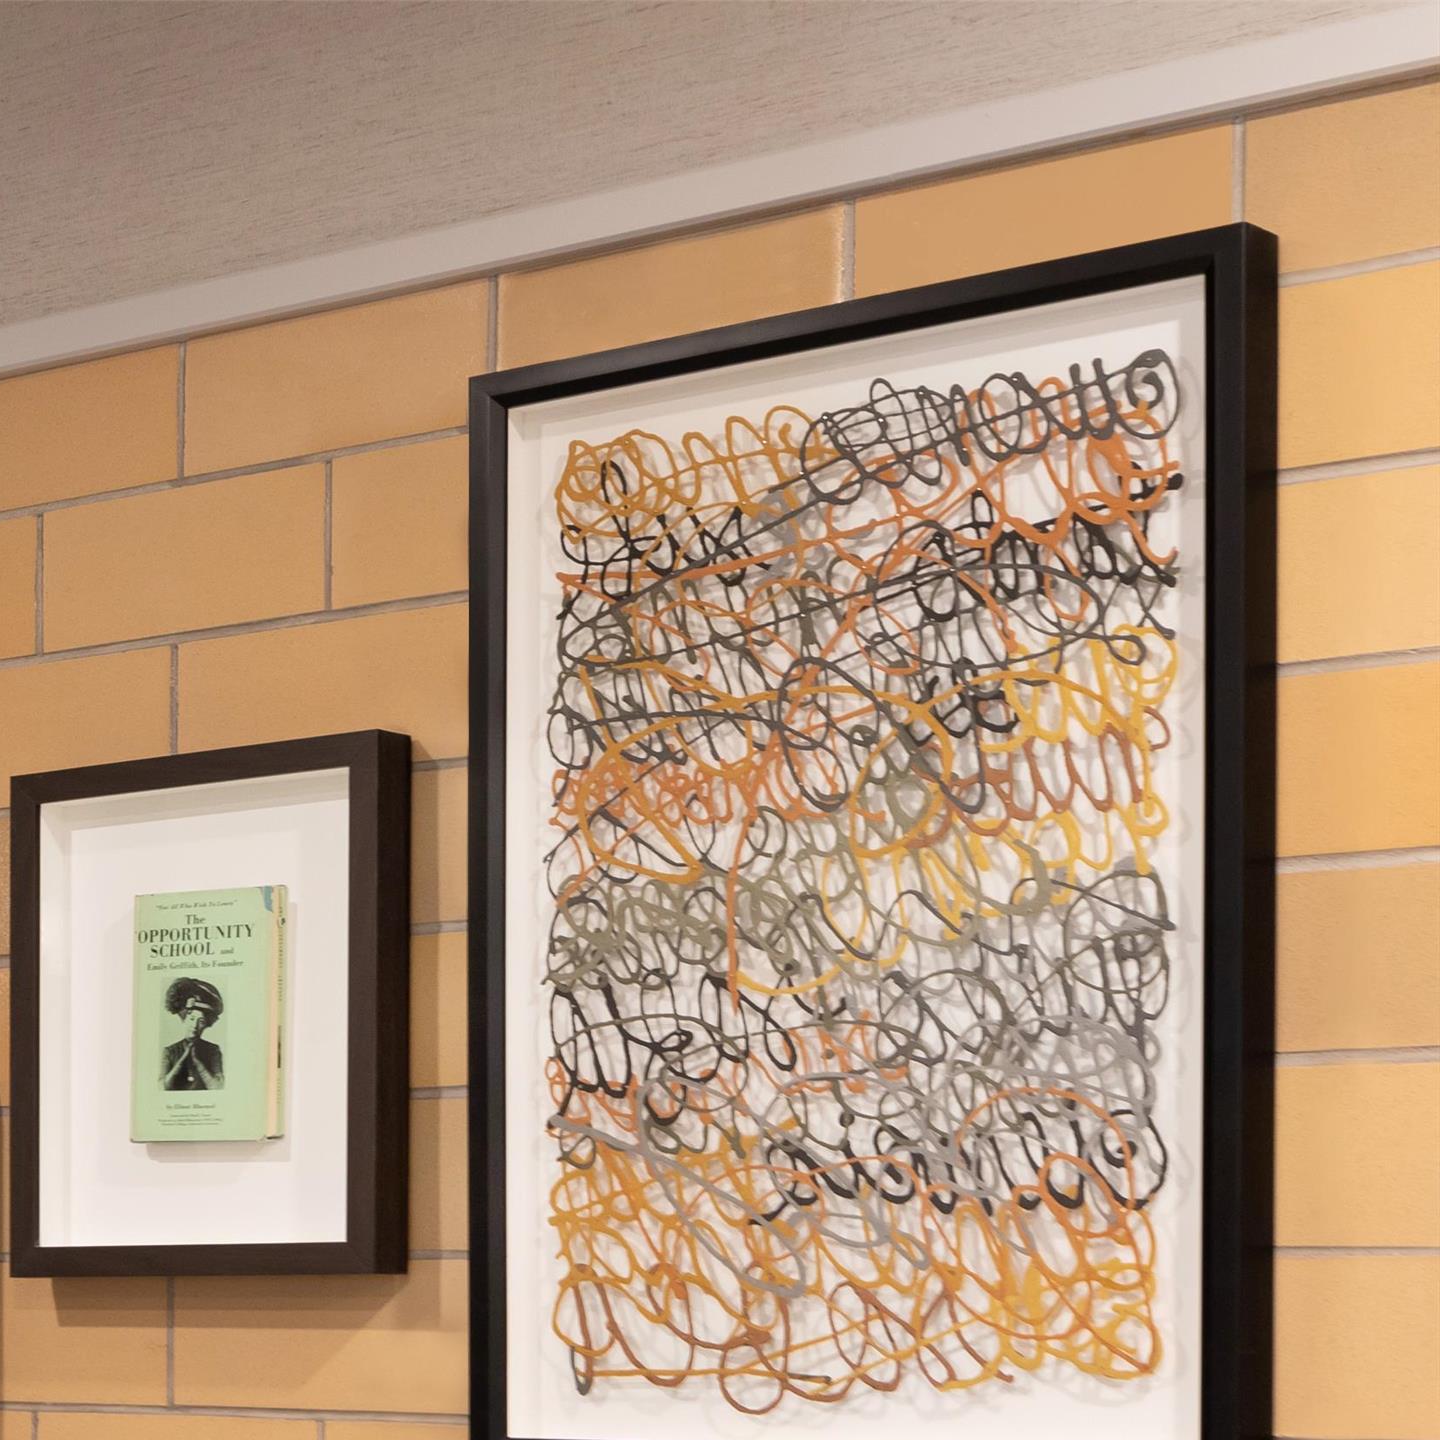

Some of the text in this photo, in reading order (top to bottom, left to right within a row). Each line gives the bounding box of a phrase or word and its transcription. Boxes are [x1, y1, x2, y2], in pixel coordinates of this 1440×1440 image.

[185, 914, 206, 925] The
[137, 923, 254, 944] OPPORTUNITY
[149, 942, 235, 959] SCHOOL and
[212, 959, 244, 968] Founder
